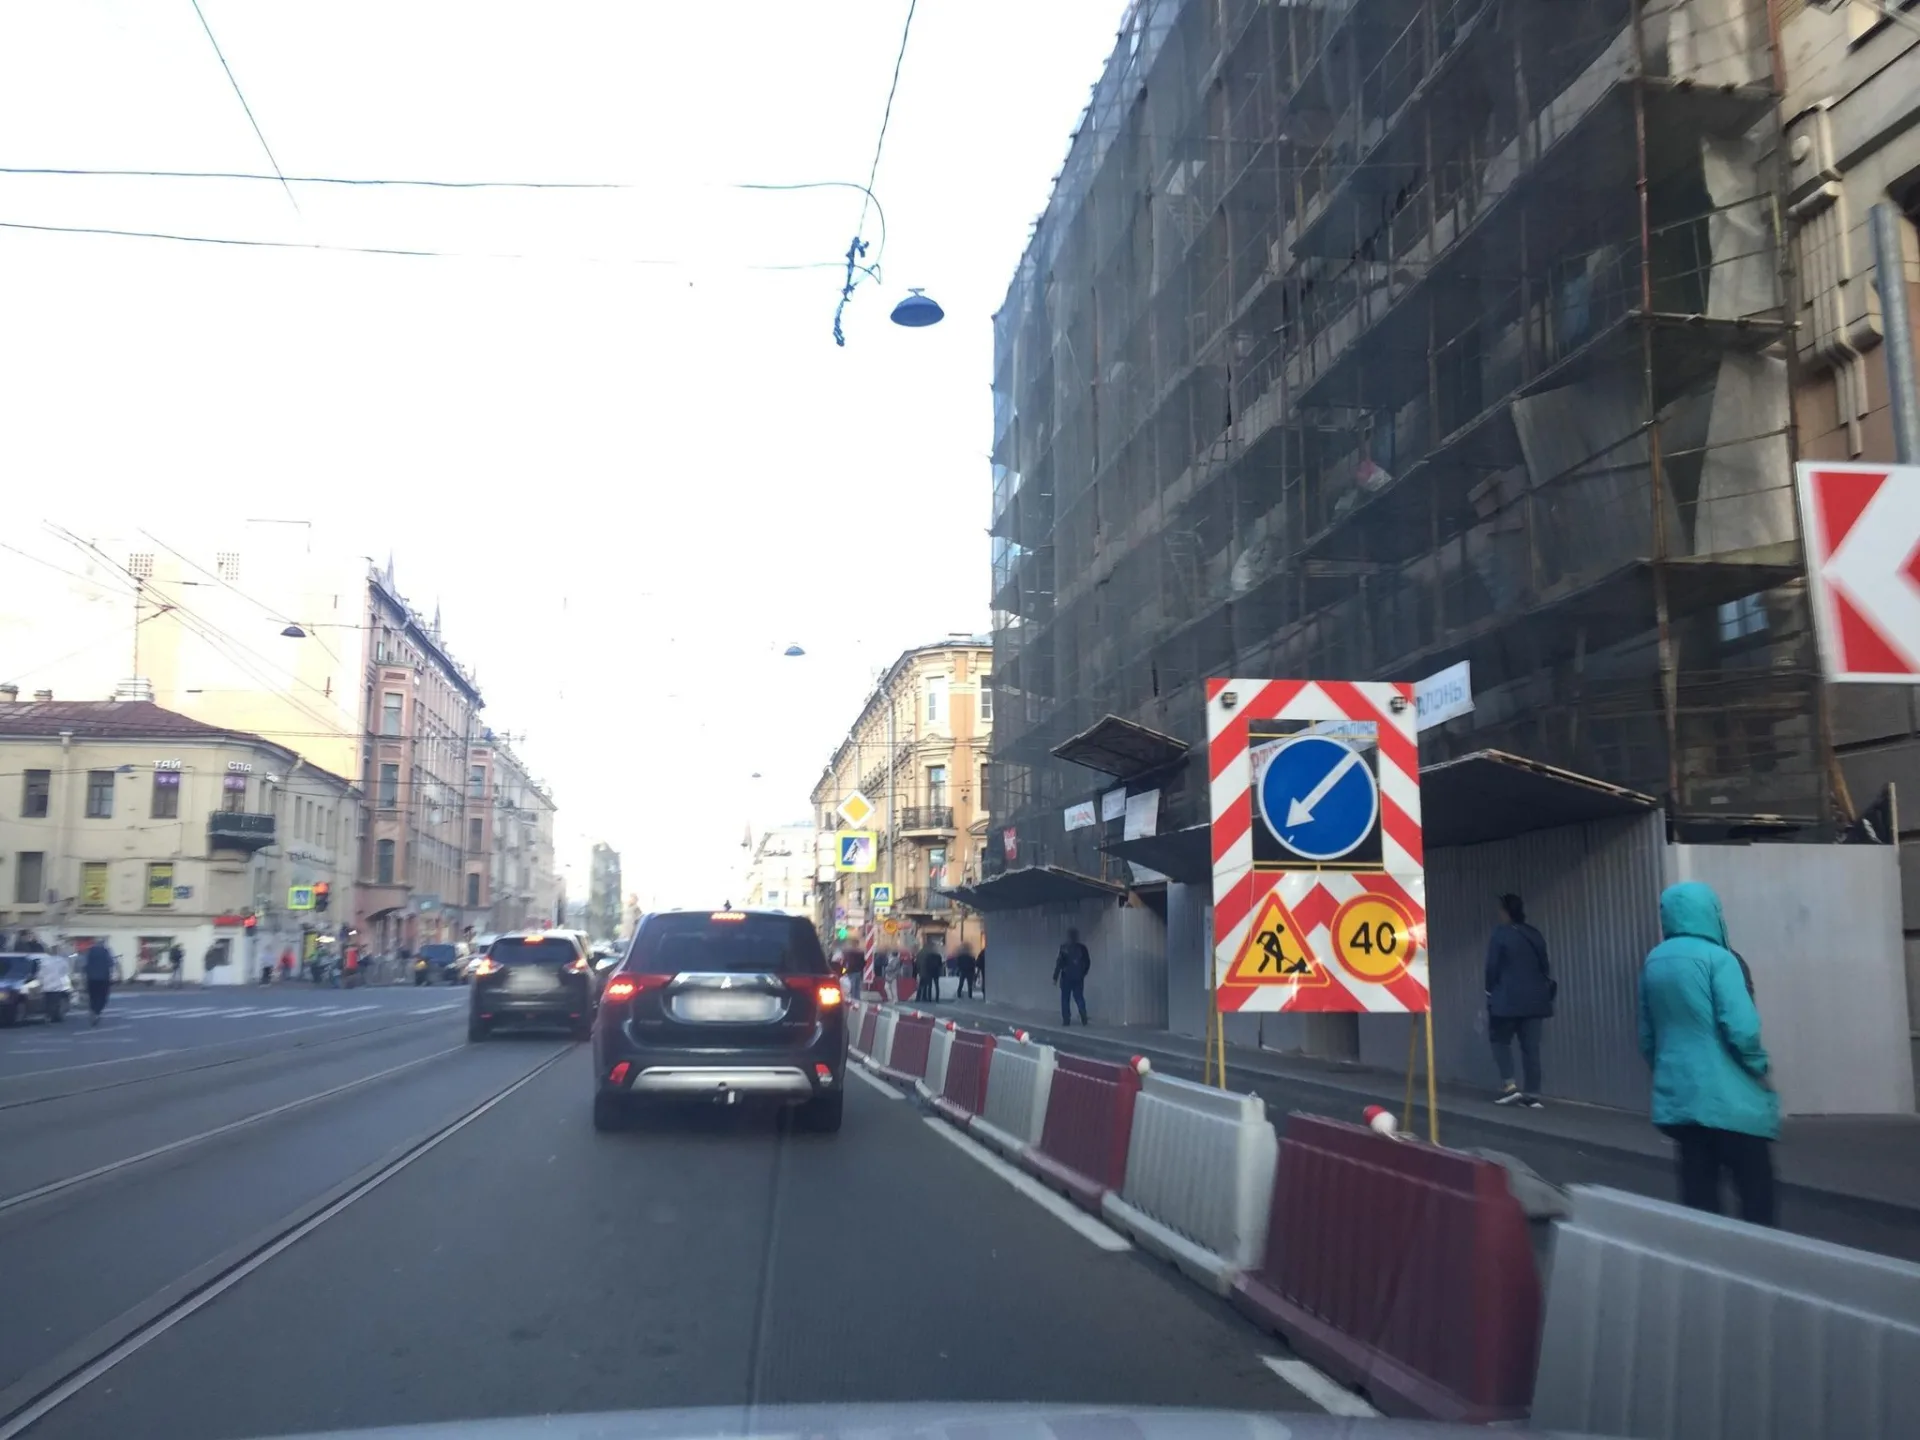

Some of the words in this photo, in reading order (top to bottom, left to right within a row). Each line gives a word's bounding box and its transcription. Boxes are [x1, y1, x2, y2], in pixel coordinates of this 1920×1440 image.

[153, 758, 181, 769] ТАЙ
[228, 761, 252, 772] СПА
[1350, 921, 1397, 955] 40
